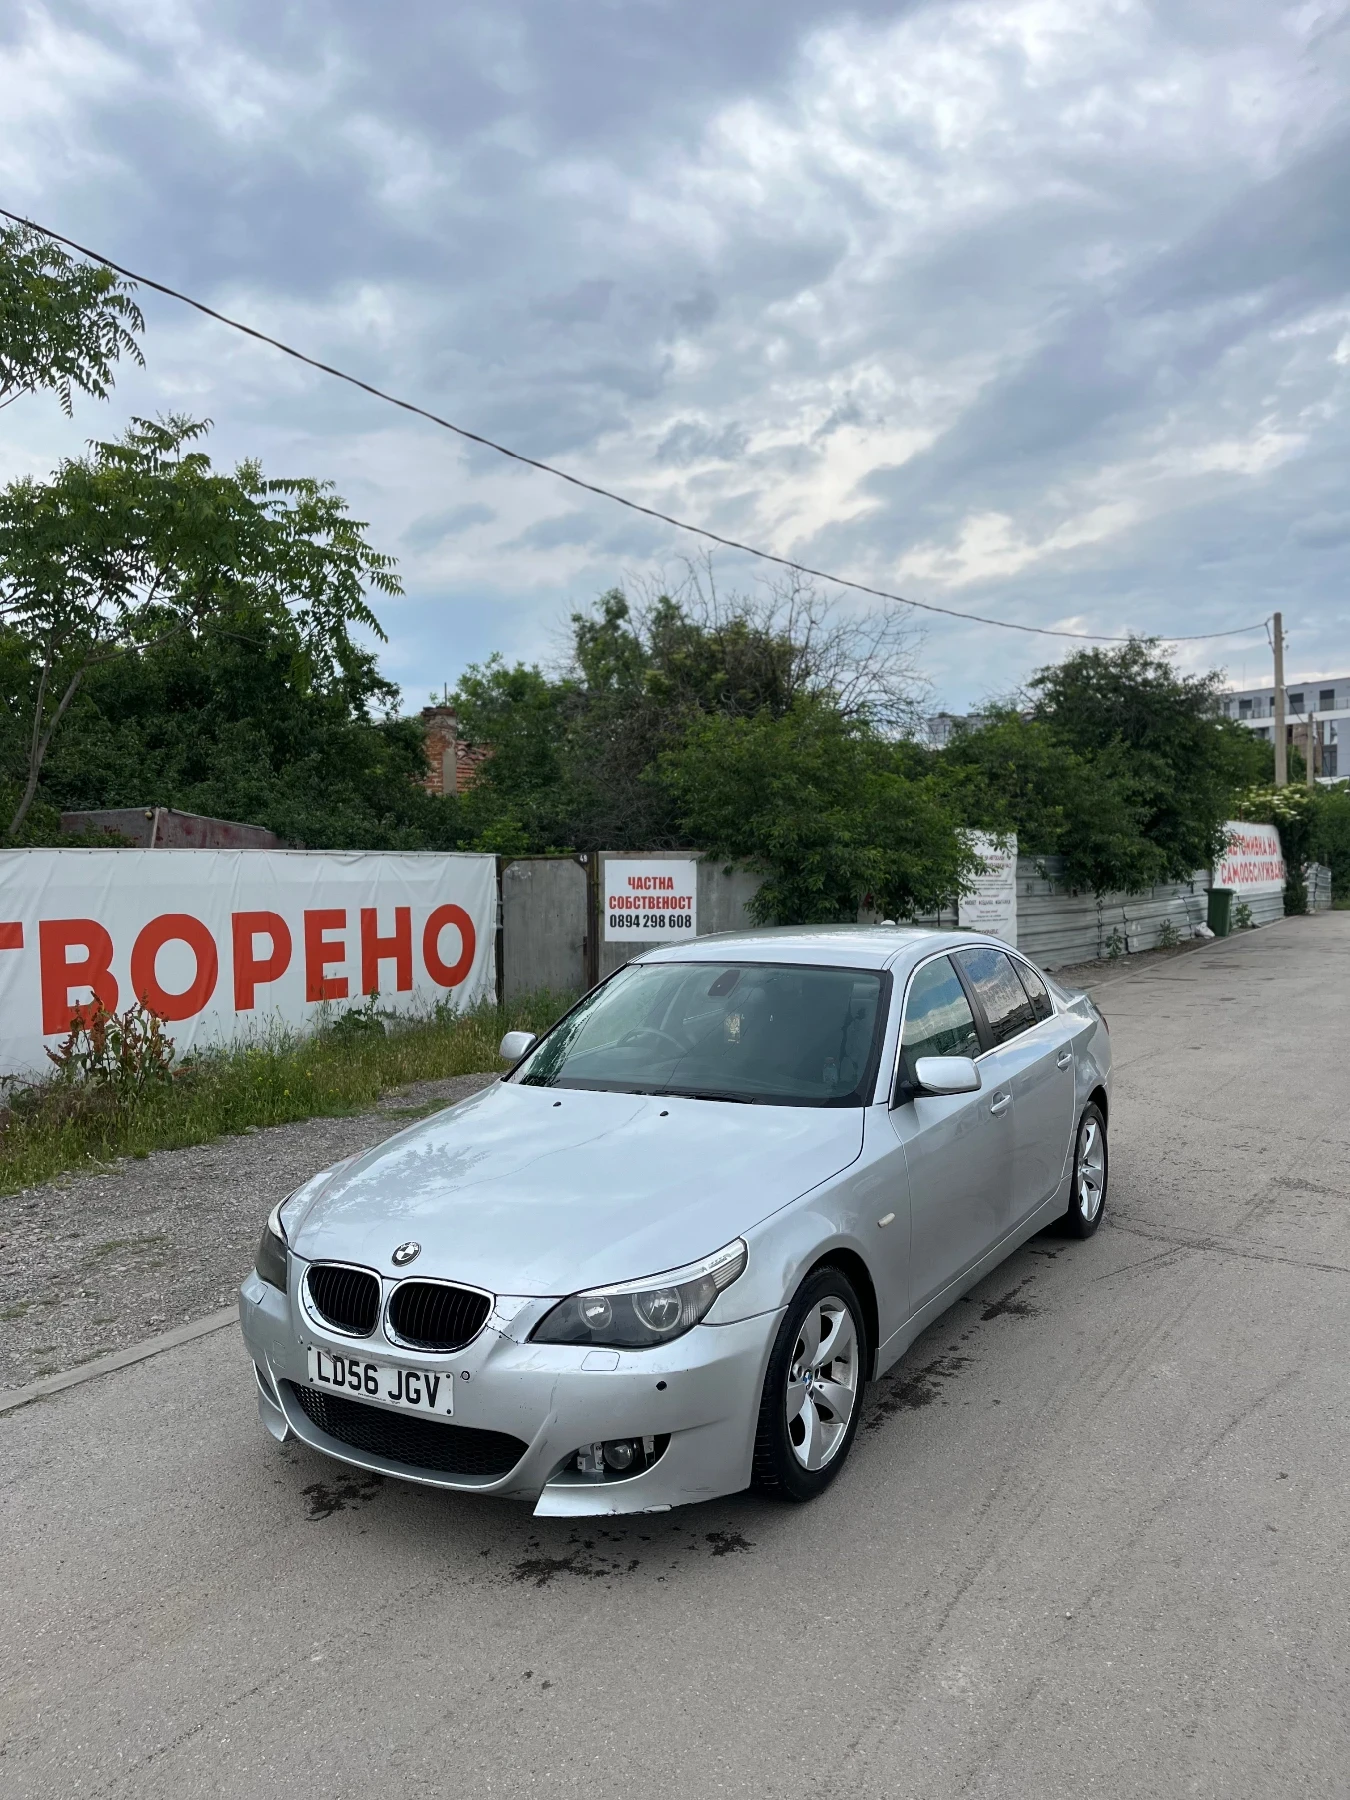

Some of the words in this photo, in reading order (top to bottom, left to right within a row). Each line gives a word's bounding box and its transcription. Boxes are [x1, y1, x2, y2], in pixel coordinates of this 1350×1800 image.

[1268, 837, 1277, 855] НА
[628, 876, 674, 890] ЧАСТНА
[609, 896, 692, 909] СОБСТВЕНОСТ
[609, 914, 640, 928] 0894
[643, 914, 665, 928] 298
[668, 914, 692, 928] 608
[317, 1351, 378, 1395] LD56
[388, 1370, 440, 1408] JGV
